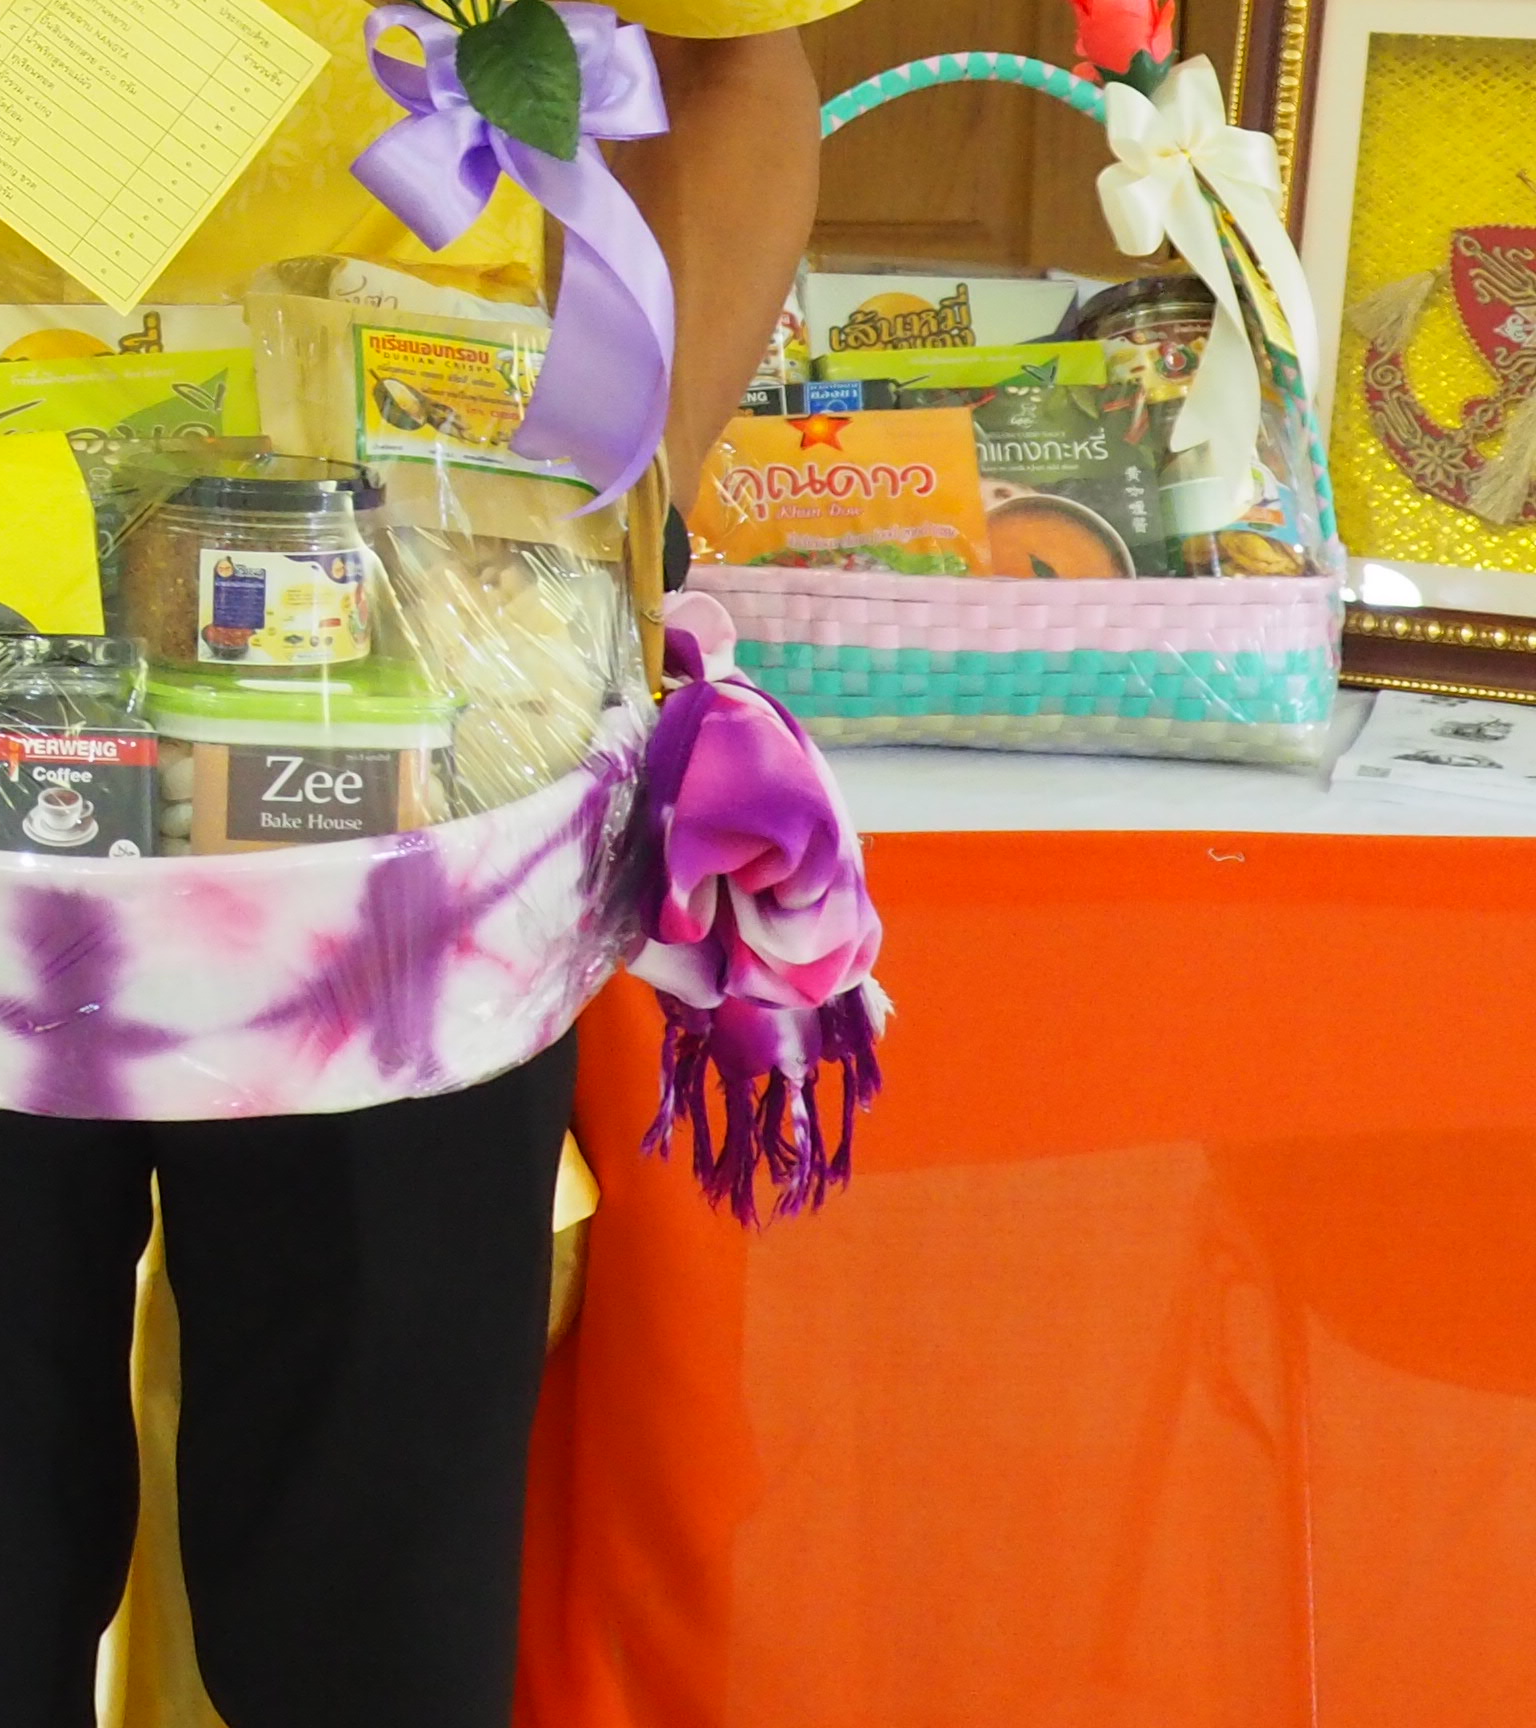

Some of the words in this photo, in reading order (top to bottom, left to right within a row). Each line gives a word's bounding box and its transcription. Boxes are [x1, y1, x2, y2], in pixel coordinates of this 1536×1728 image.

[92, 29, 130, 60] NANGTA
[383, 352, 435, 365] DURIAN
[444, 360, 491, 373] CRISPY
[720, 463, 936, 521] คุณดาว
[33, 767, 93, 783] Coffee
[262, 756, 363, 804] Zee
[261, 812, 302, 829] Bake
[308, 813, 363, 831] House
